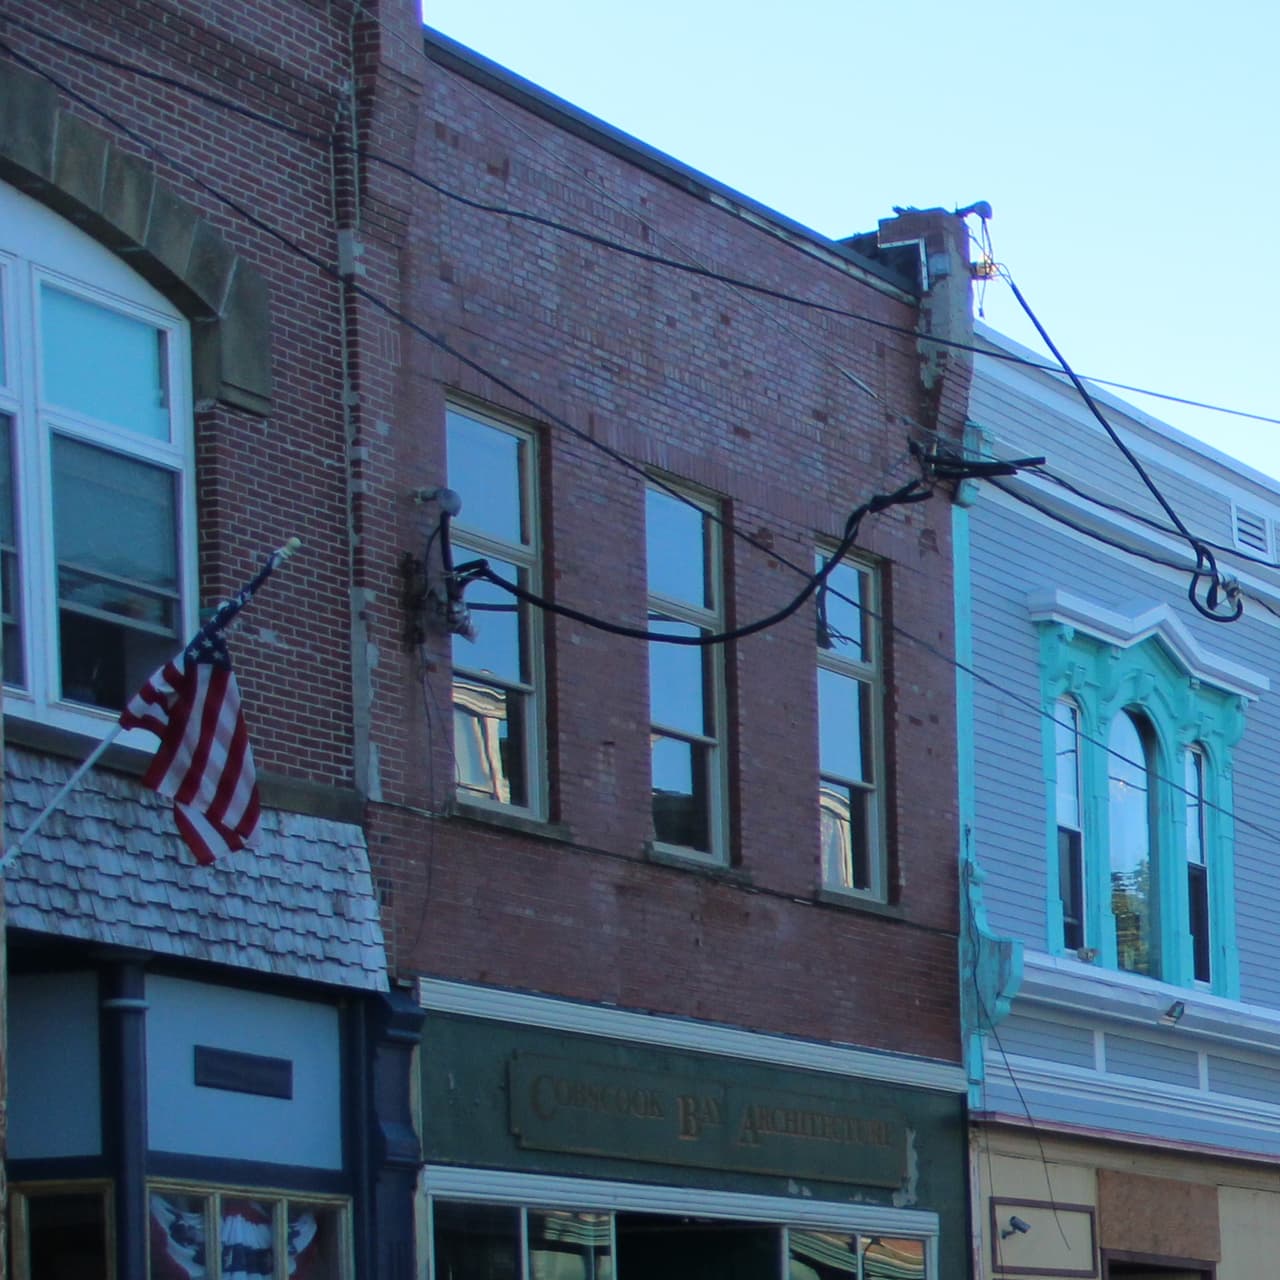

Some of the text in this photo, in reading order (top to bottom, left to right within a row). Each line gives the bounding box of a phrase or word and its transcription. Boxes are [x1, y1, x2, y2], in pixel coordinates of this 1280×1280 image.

[529, 1073, 896, 1149] COBSCOOK BAY ARCHITECTURE
